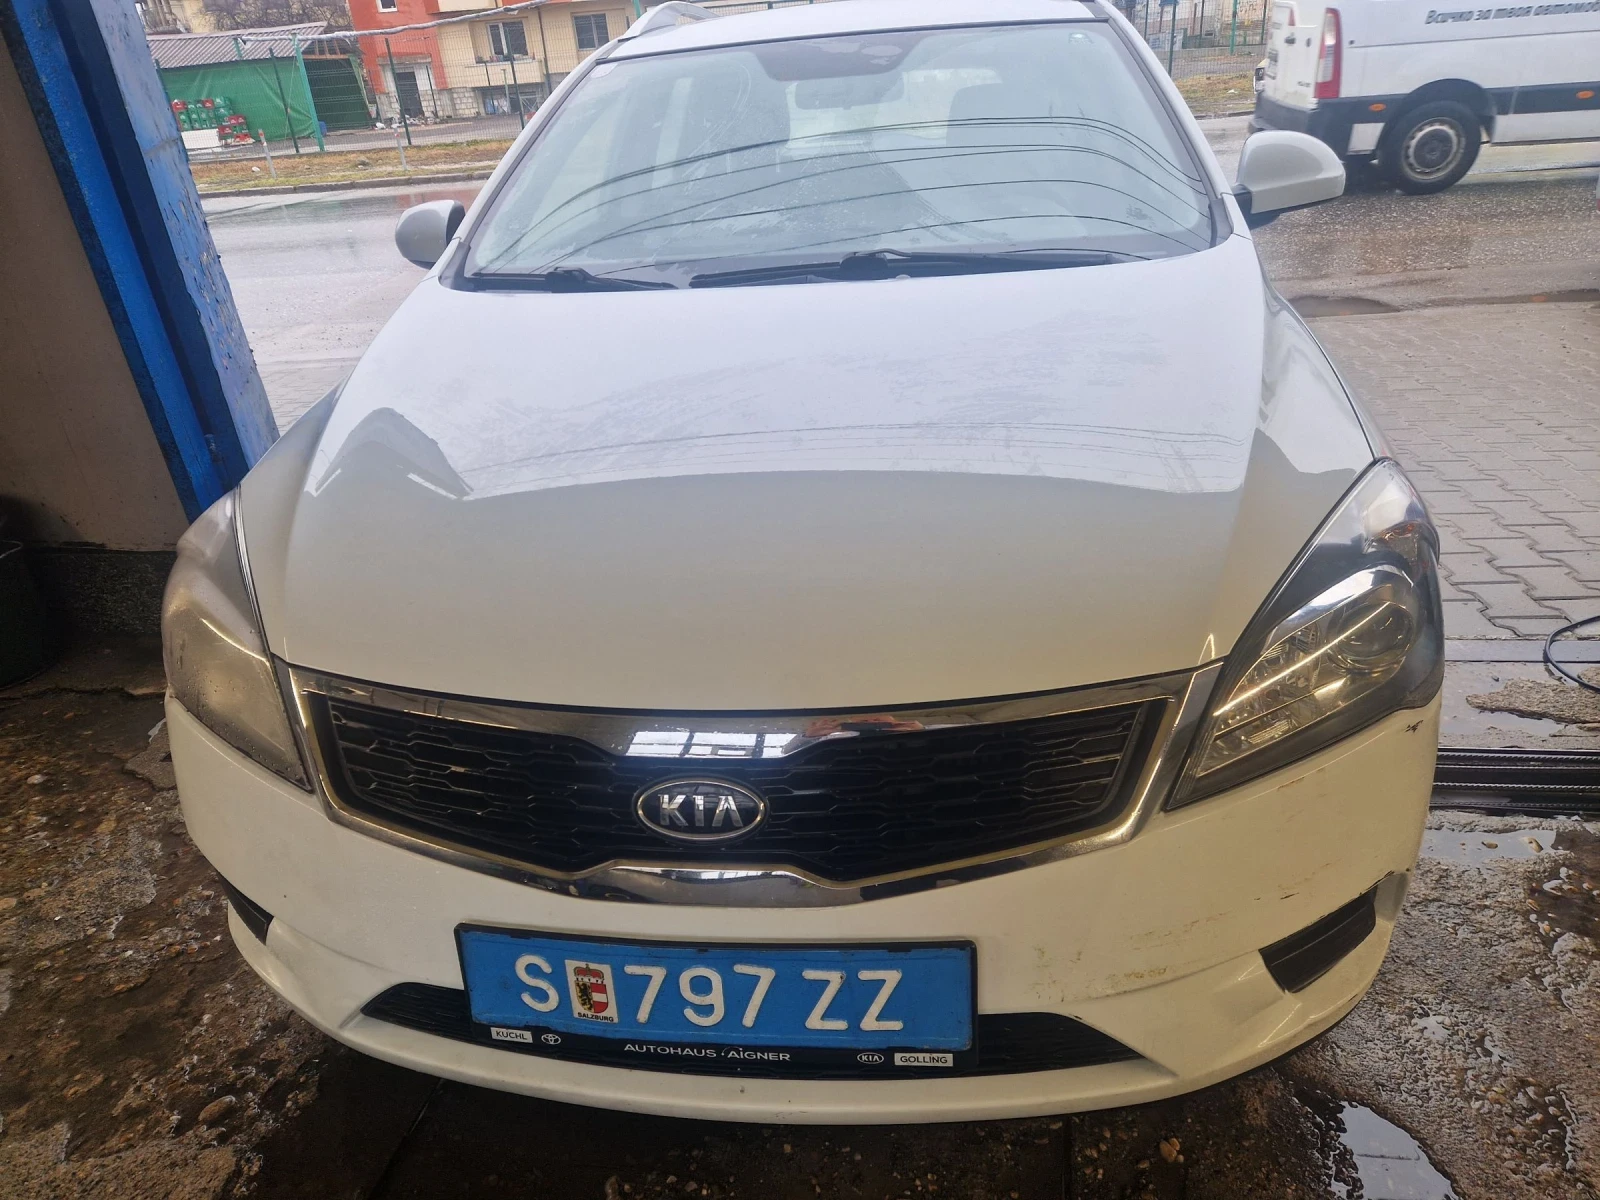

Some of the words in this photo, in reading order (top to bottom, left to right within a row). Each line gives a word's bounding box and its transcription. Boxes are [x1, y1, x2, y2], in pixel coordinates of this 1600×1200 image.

[1425, 10, 1474, 24] Всичко
[1474, 9, 1493, 20] за
[658, 794, 744, 827] KIA
[515, 953, 560, 1013] S
[624, 963, 776, 1029] 797
[802, 969, 904, 1031] ZZ
[577, 1012, 615, 1023] SALZBURG
[495, 1030, 528, 1041] KUCHL
[623, 1043, 717, 1058] AUTOHAUS
[900, 1055, 948, 1064] GOLLING
